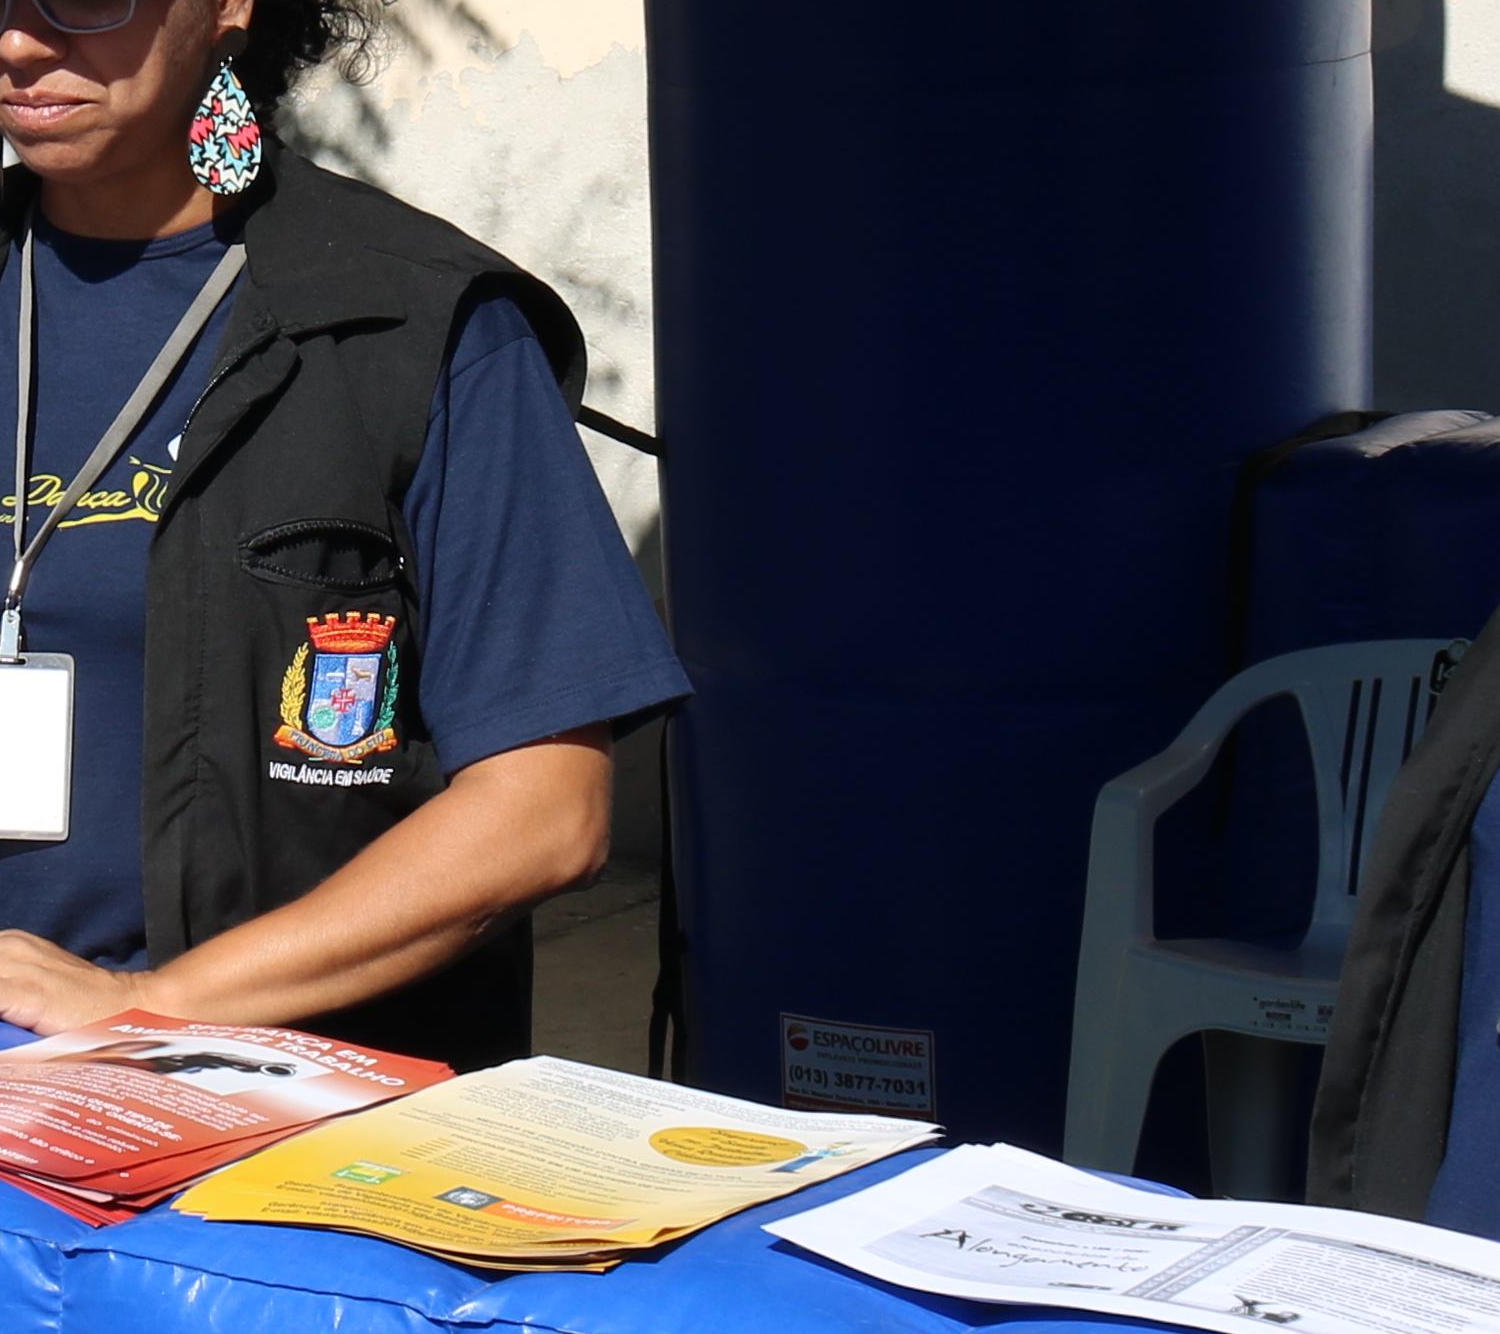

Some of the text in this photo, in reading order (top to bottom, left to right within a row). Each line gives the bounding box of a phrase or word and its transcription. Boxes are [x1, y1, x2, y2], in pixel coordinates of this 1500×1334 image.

[269, 761, 393, 787] VIGILÂNCIA EM SAÚDE
[813, 1029, 926, 1058] ESPAÇOLIVRE
[234, 1033, 273, 1045] DE
[273, 1040, 406, 1088] TRABALHO
[338, 1049, 379, 1068] EM
[789, 1064, 926, 1095] (013) 3877-7031
